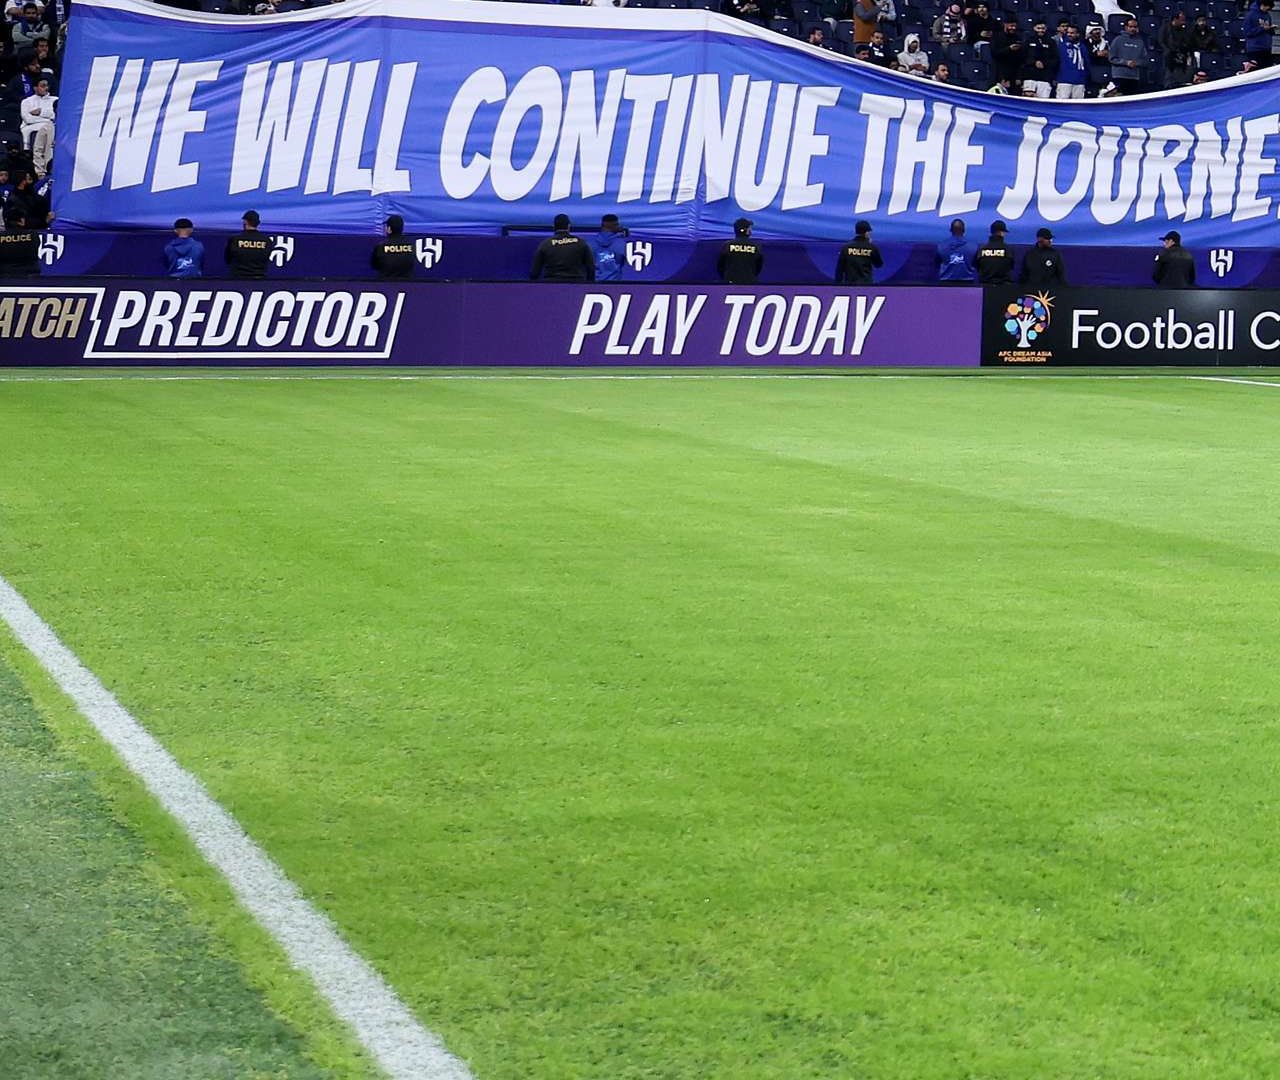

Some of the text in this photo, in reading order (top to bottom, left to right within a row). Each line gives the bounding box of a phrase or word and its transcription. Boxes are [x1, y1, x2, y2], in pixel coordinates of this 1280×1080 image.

[71, 55, 224, 193] WE
[228, 58, 419, 196] WILL
[440, 66, 842, 213] CONTINUE
[854, 93, 993, 217] THE
[0, 234, 32, 243] POLICE
[551, 237, 579, 246] Police
[238, 240, 267, 249] POLICE
[384, 245, 412, 253] POLICE
[729, 244, 756, 254] POLICE
[848, 248, 873, 257] POLICE
[981, 248, 1005, 258] POLICE
[0, 291, 390, 347] ATCH PREDICTOR
[569, 294, 886, 356] PLAY TODAY
[1071, 309, 1234, 351] Football
